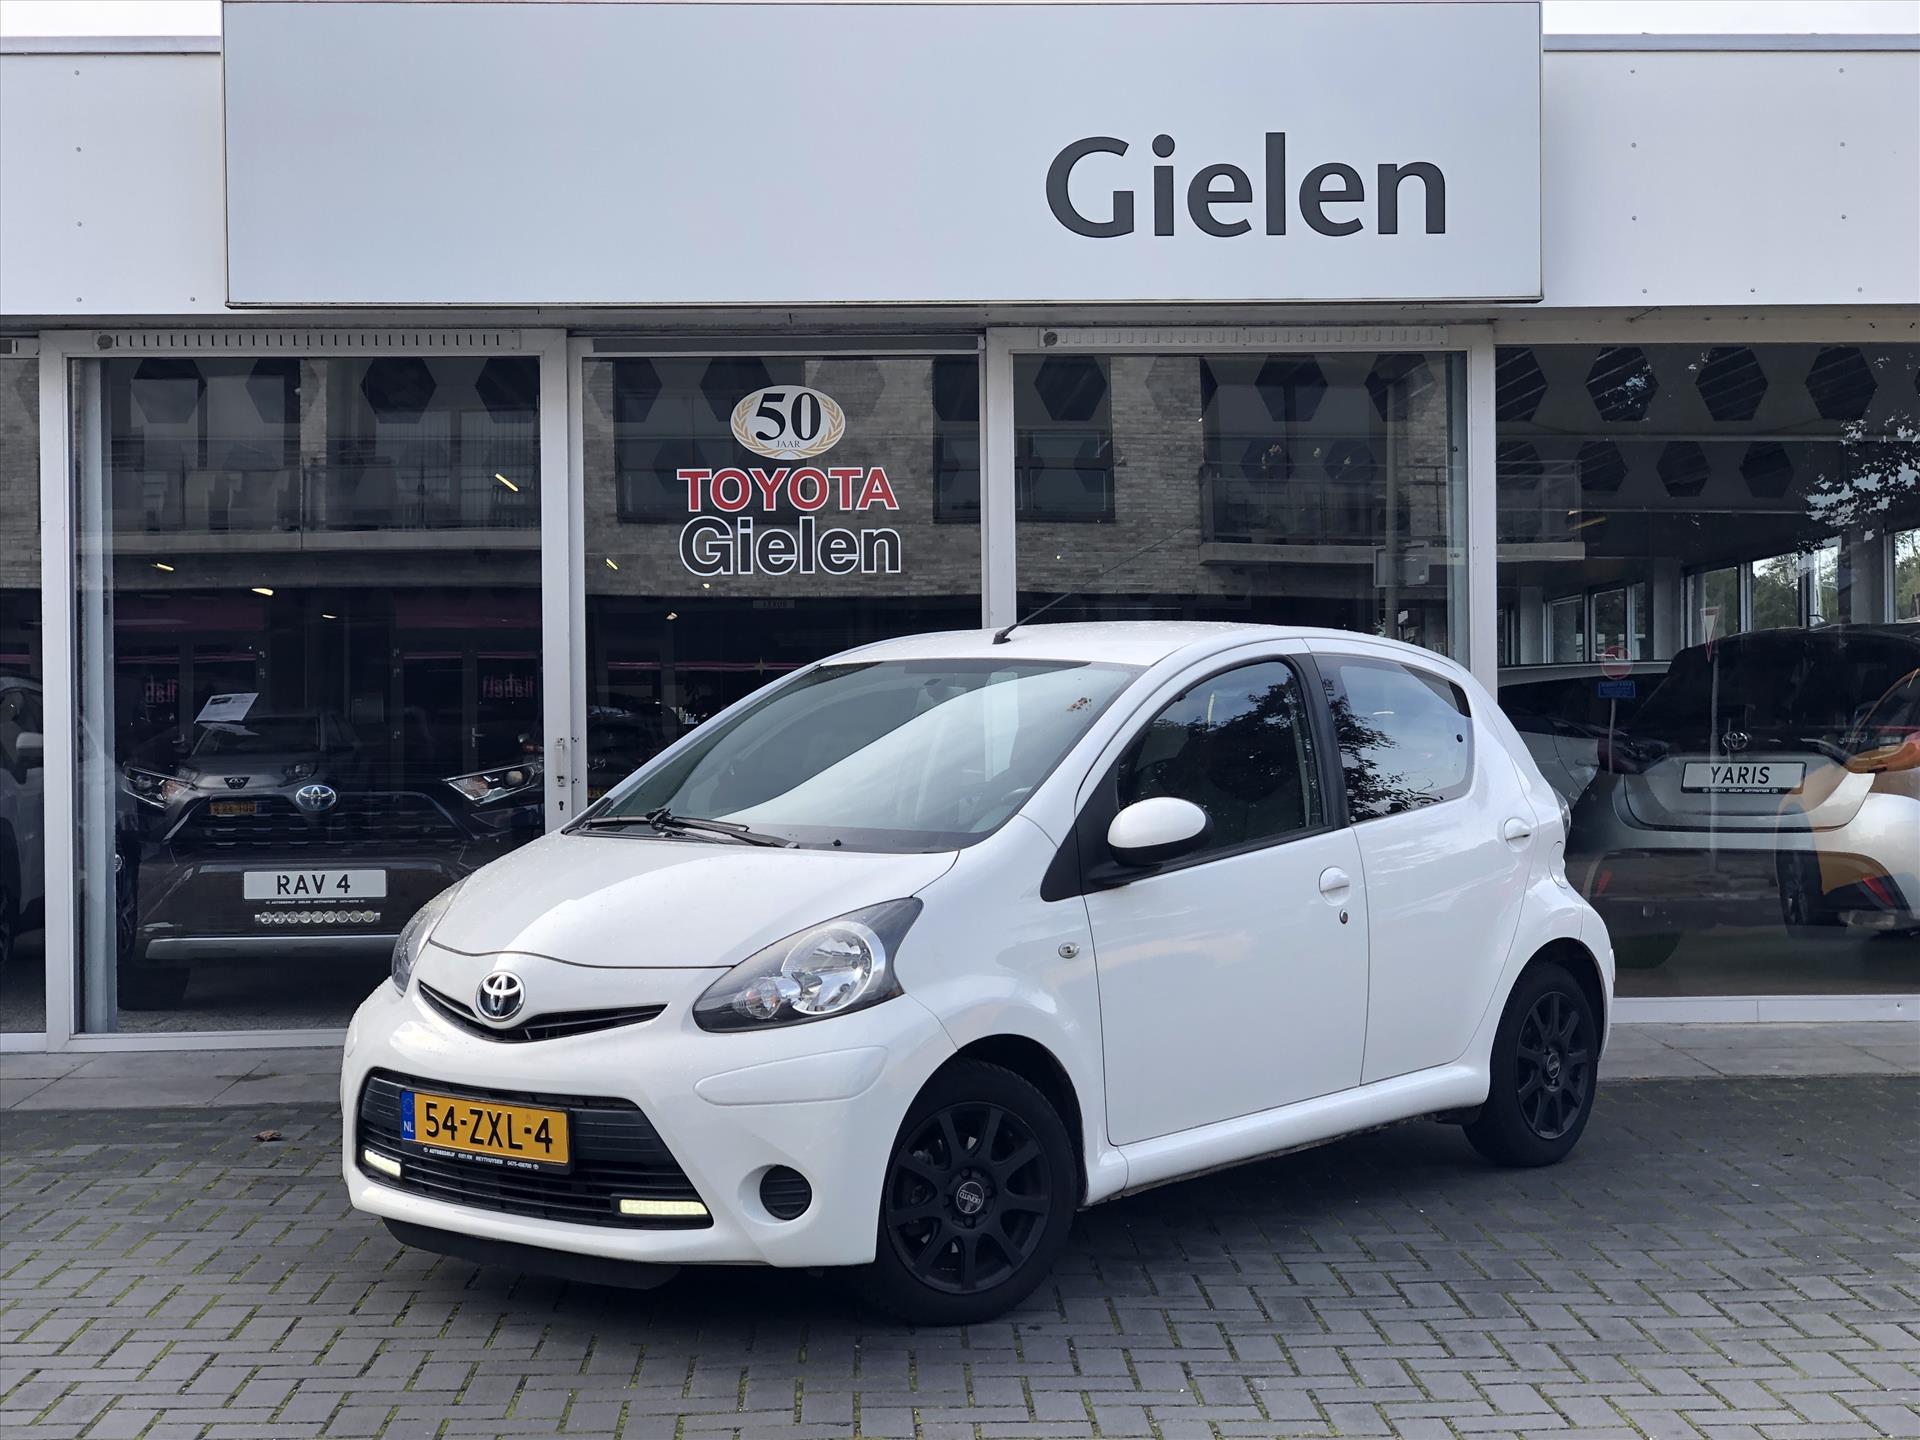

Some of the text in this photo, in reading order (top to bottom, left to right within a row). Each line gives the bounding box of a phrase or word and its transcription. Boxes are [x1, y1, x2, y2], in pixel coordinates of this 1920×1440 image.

[1045, 131, 1446, 238] Gielen
[755, 392, 821, 441] 50
[776, 440, 800, 448] JAAR
[677, 467, 900, 512] TOYOTA
[679, 516, 902, 576] Gielen
[1710, 766, 1770, 785] YARIS
[276, 874, 351, 895] RAV 4
[403, 1120, 414, 1133] NL
[425, 1102, 553, 1153] 54-ZXL-4
